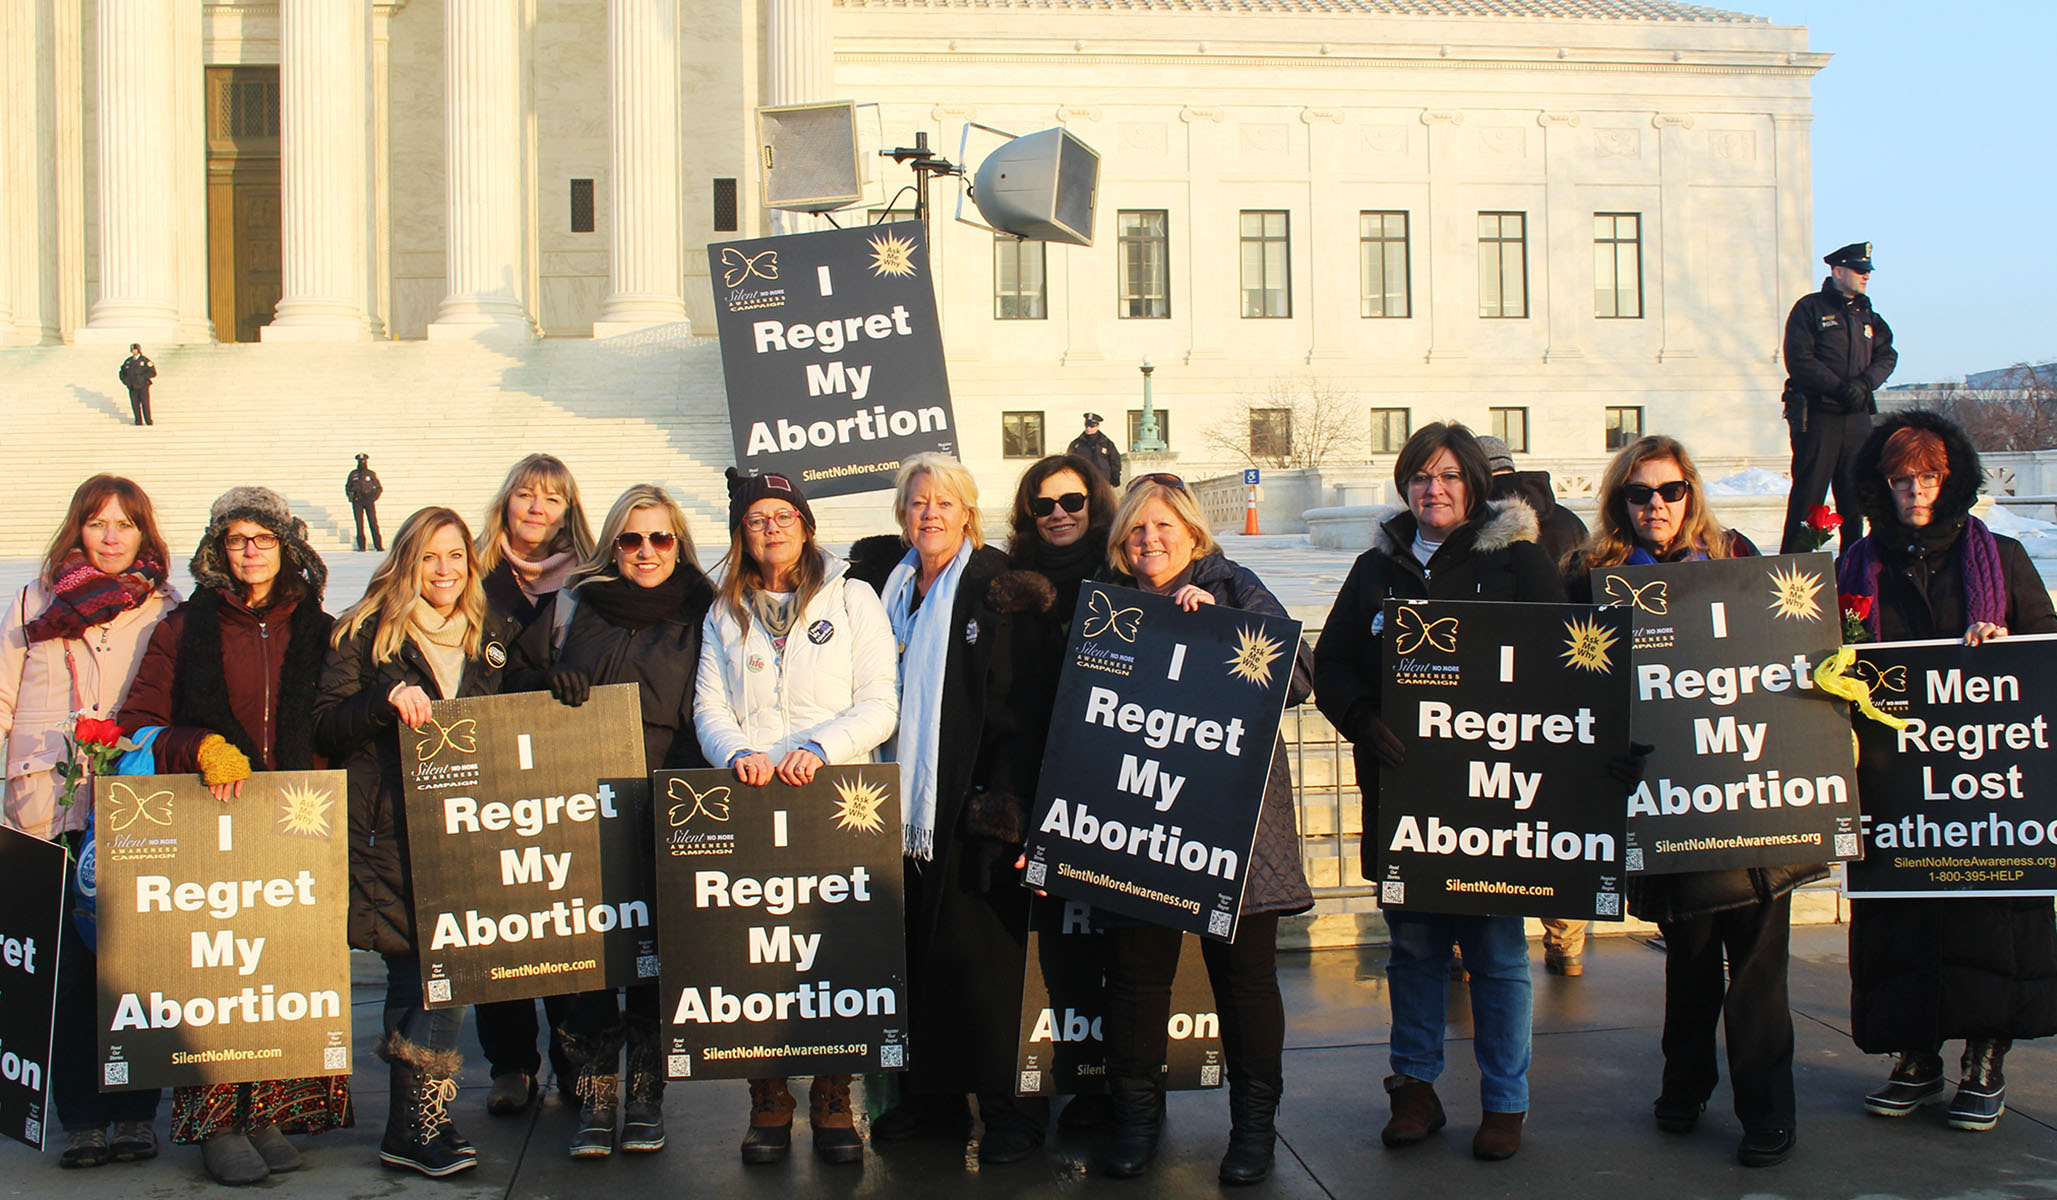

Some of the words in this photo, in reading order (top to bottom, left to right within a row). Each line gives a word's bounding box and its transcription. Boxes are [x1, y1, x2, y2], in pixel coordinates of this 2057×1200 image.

[725, 289, 758, 301] Silent
[817, 265, 833, 297] I
[730, 301, 785, 311] CAMPAIGN
[753, 304, 913, 354] Regret
[805, 361, 872, 400] My
[746, 405, 948, 457] Abortion
[802, 460, 900, 482] SilentNoMore.com
[1785, 597, 1804, 609] Why
[1789, 583, 1805, 592] Ask
[1711, 602, 1728, 638] I
[1075, 640, 1110, 658] Silent
[1250, 645, 1265, 656] Ask
[1577, 647, 1597, 661] Why
[1581, 641, 1596, 652] Me
[1582, 634, 1599, 645] Ask
[1076, 661, 1130, 676] CAMPAIGN
[1167, 643, 1187, 681] I
[1242, 656, 1260, 673] Why
[1247, 651, 1260, 663] Me
[1392, 657, 1430, 671] Silent
[1499, 645, 1514, 683] I
[1396, 672, 1460, 680] AWARENESS
[1396, 678, 1458, 686] CAMPAIGN
[1637, 654, 1814, 706] Regret
[1926, 668, 2019, 705] Men
[1084, 686, 1245, 757] Regret
[1418, 700, 1596, 751] Regret
[1897, 713, 2049, 761] Regret
[517, 733, 533, 770] I
[1693, 716, 1768, 762] My
[411, 761, 449, 777] Silent
[417, 780, 479, 790] CAMPAIGN
[1117, 753, 1186, 812] My
[1468, 760, 1543, 810] My
[1922, 764, 2024, 801] Lost
[443, 783, 618, 837] Regret
[852, 801, 866, 811] Me
[853, 795, 869, 804] Ask
[1627, 770, 1848, 818] Abortion
[773, 810, 788, 847] I
[849, 808, 867, 820] Why
[106, 833, 147, 848] Silent
[218, 815, 233, 852] I
[666, 829, 705, 844] Silent
[670, 842, 735, 850] AWARENESS
[1039, 797, 1239, 881] Abortion
[1389, 815, 1615, 862] Abortion
[1655, 832, 1822, 854] SilentNoMoreAwareness.org
[499, 846, 572, 891] My
[1894, 856, 2056, 869] SilentNoMoreAwareness.org
[1929, 870, 2024, 882] 1-800-395-HELP
[136, 870, 316, 919] Regret
[695, 866, 871, 915] Regret
[1057, 863, 1201, 914] SilentNoMoreAwareness.org
[1445, 878, 1554, 897] SilentNoMore.com
[430, 897, 649, 950] Abortion
[190, 930, 266, 976] My
[748, 925, 822, 972] My
[490, 959, 597, 980] SilentNoMore.com
[110, 984, 341, 1032] Abortion
[672, 981, 896, 1025] Abortion
[172, 1047, 283, 1066] SilentNoMore.com
[703, 1043, 868, 1060] SilentNoMoreAwareness.org
